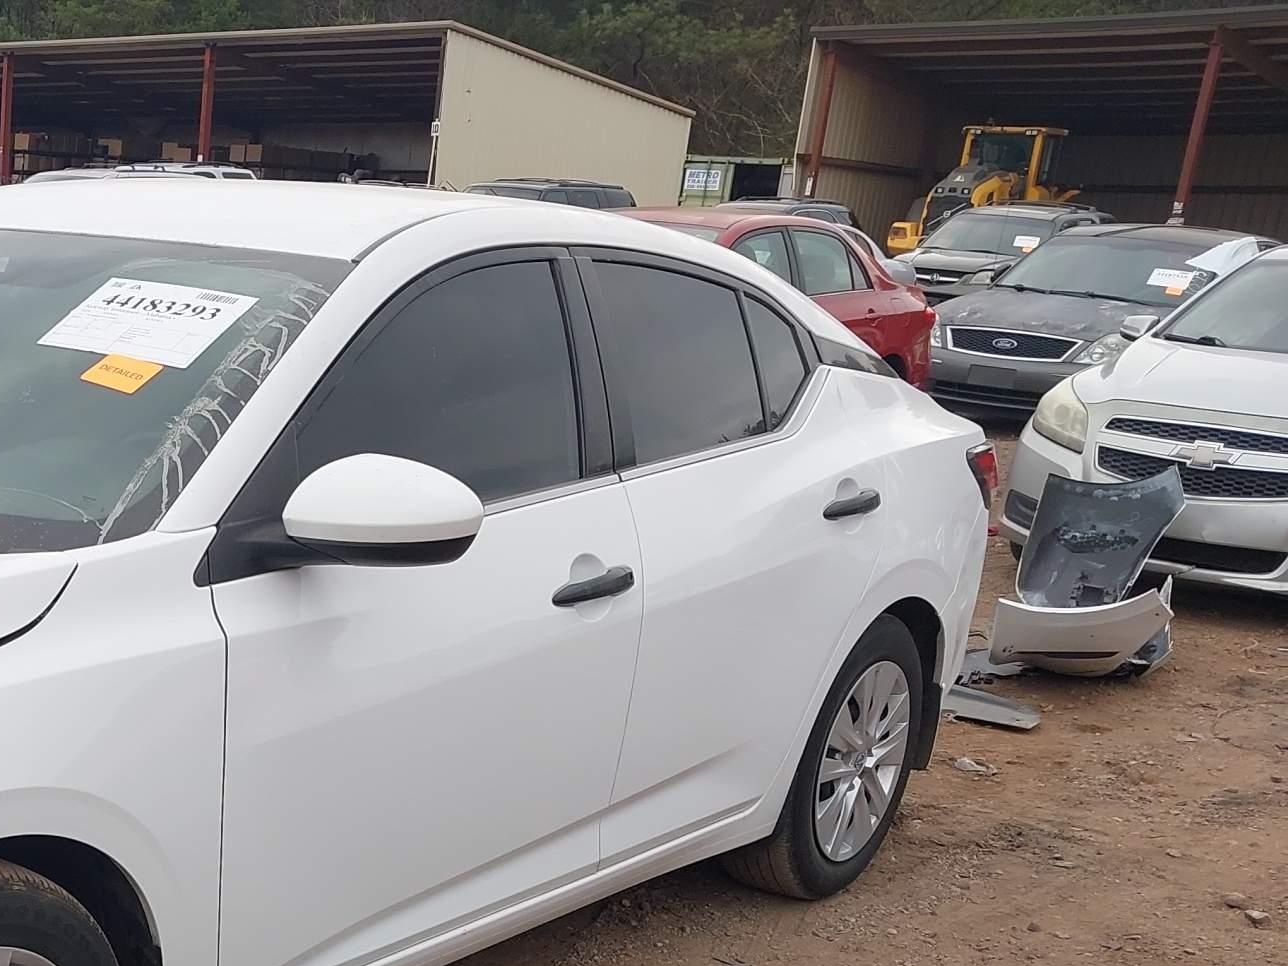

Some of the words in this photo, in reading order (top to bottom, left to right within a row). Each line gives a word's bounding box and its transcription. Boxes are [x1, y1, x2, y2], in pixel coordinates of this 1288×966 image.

[688, 170, 720, 179] METRO
[102, 293, 222, 321] 44183293
[99, 363, 144, 381] DETAILED
